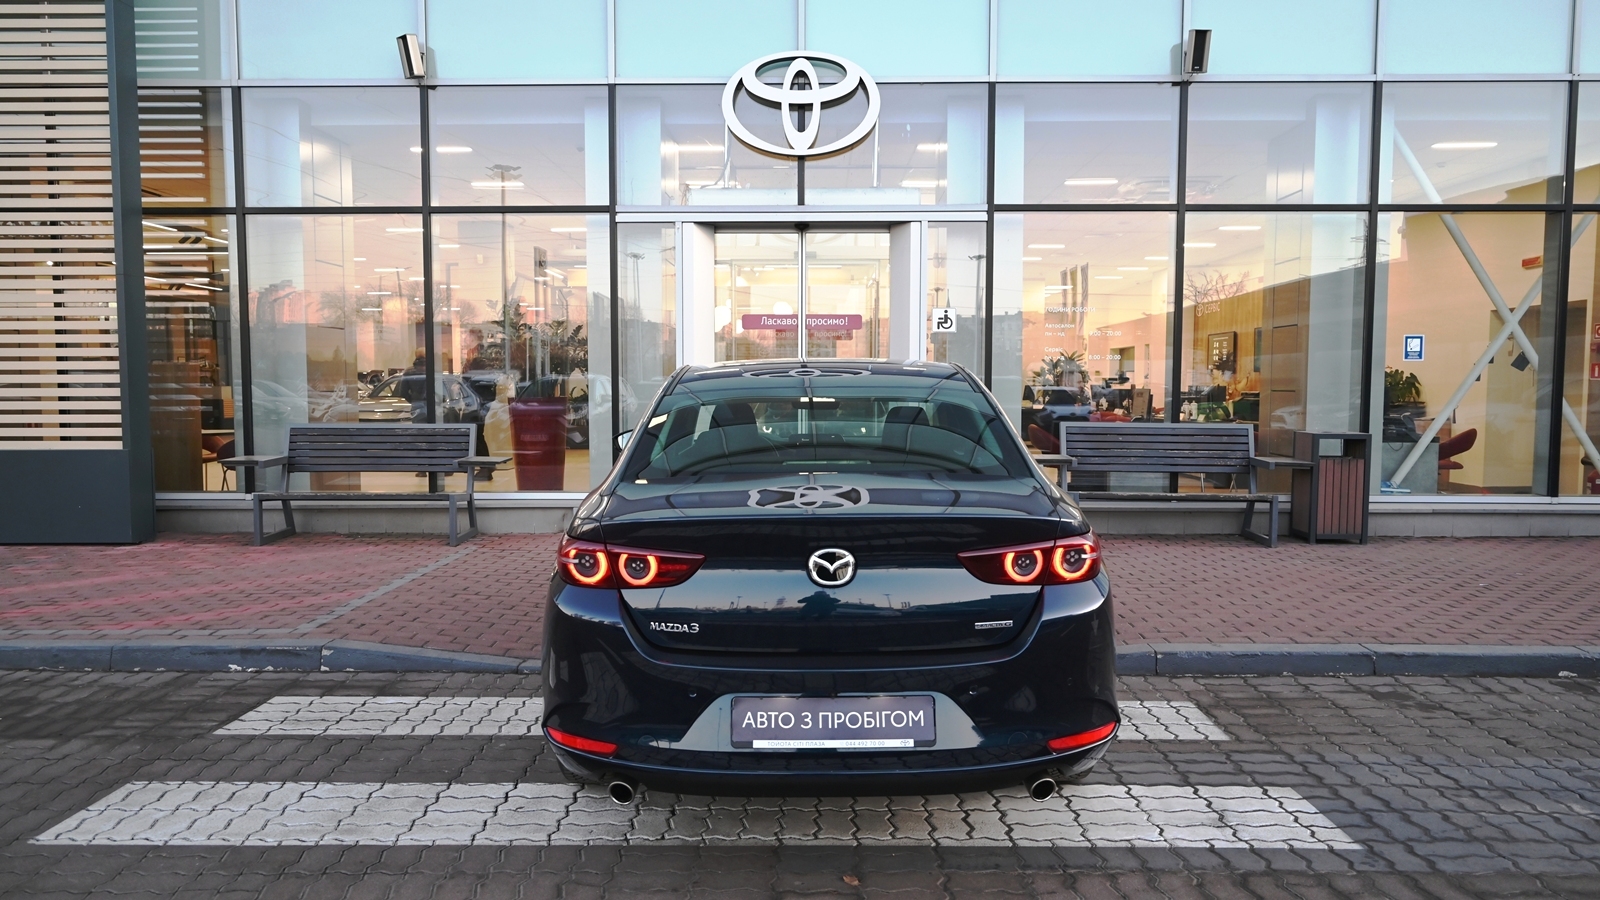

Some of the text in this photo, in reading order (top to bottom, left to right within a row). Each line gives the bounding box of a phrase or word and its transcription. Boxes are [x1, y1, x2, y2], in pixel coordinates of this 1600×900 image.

[760, 316, 848, 327] Ласкаво просимо!
[741, 711, 795, 729] АВТО
[818, 710, 925, 729] ПРОБІГОМ
